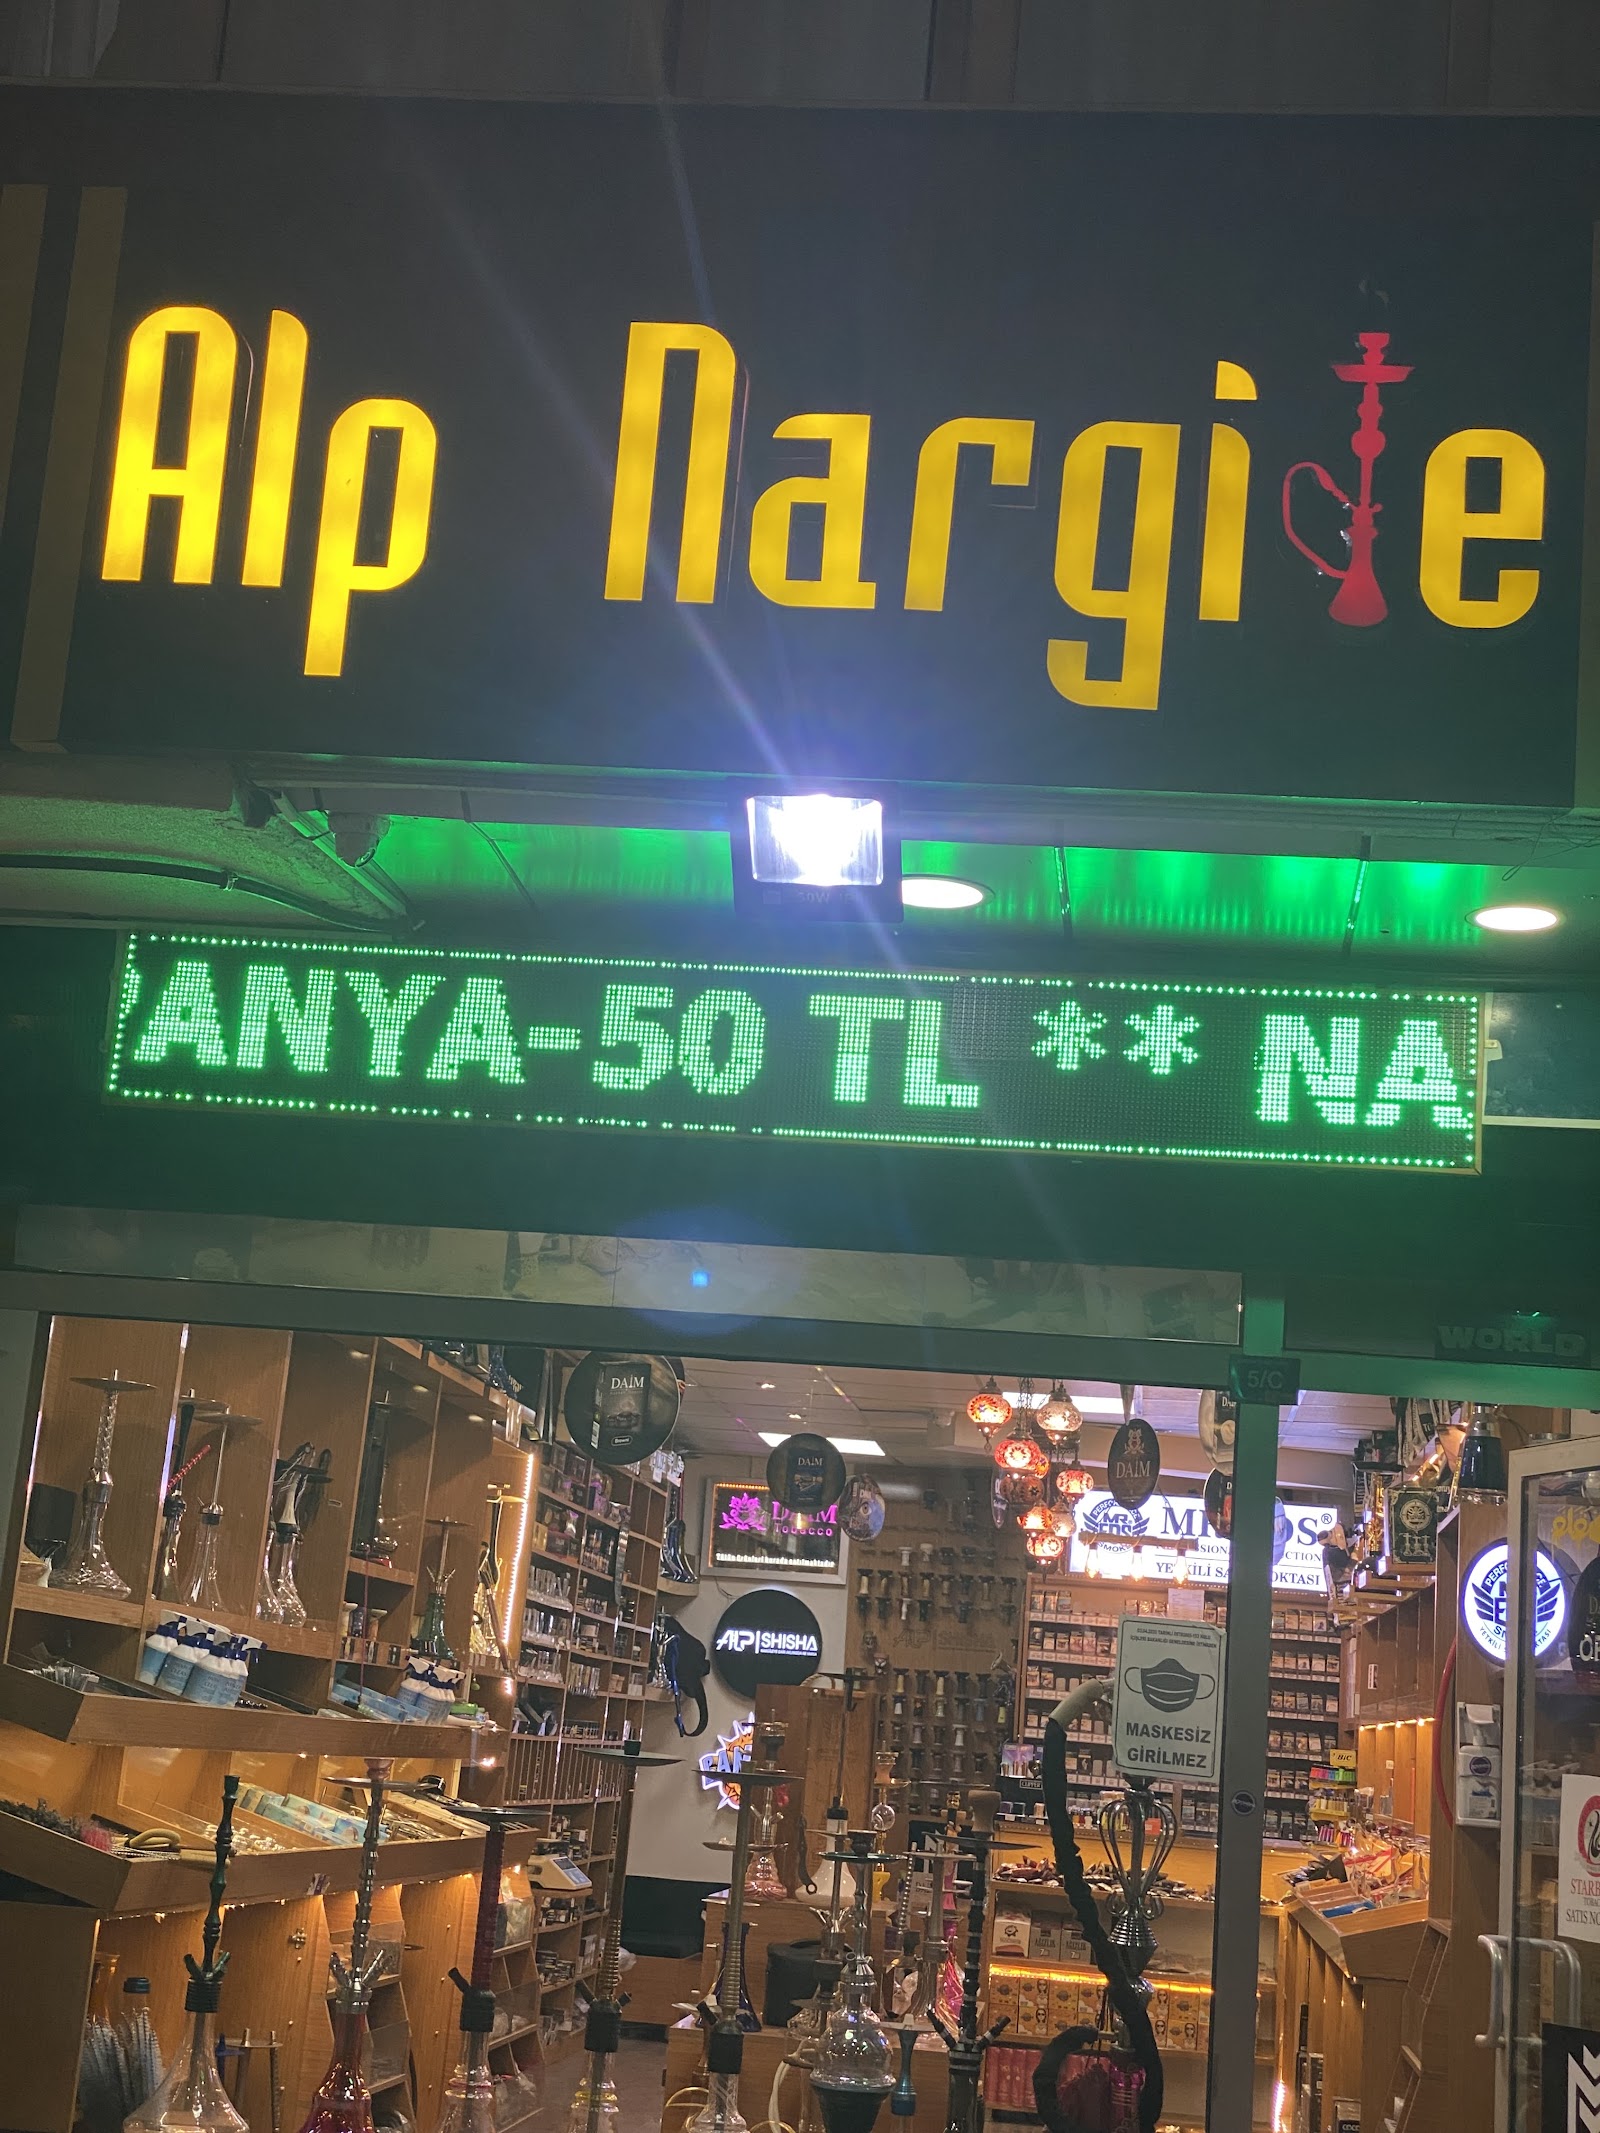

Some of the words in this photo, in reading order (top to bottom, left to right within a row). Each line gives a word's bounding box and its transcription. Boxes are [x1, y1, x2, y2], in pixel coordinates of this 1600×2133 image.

[101, 306, 437, 677] Alp
[122, 960, 767, 1095] ANYA-50
[809, 994, 981, 1108] TL
[1253, 1014, 1472, 1130] NA
[1437, 1325, 1586, 1357] WORLD
[1156, 1560, 1211, 1578] YEKİLİ
[1271, 1570, 1320, 1586] OKTASI
[760, 1632, 818, 1652] SHISHA
[1126, 1722, 1211, 1744] MASKESİZ
[1127, 1745, 1207, 1768] GİRİLMEZ
